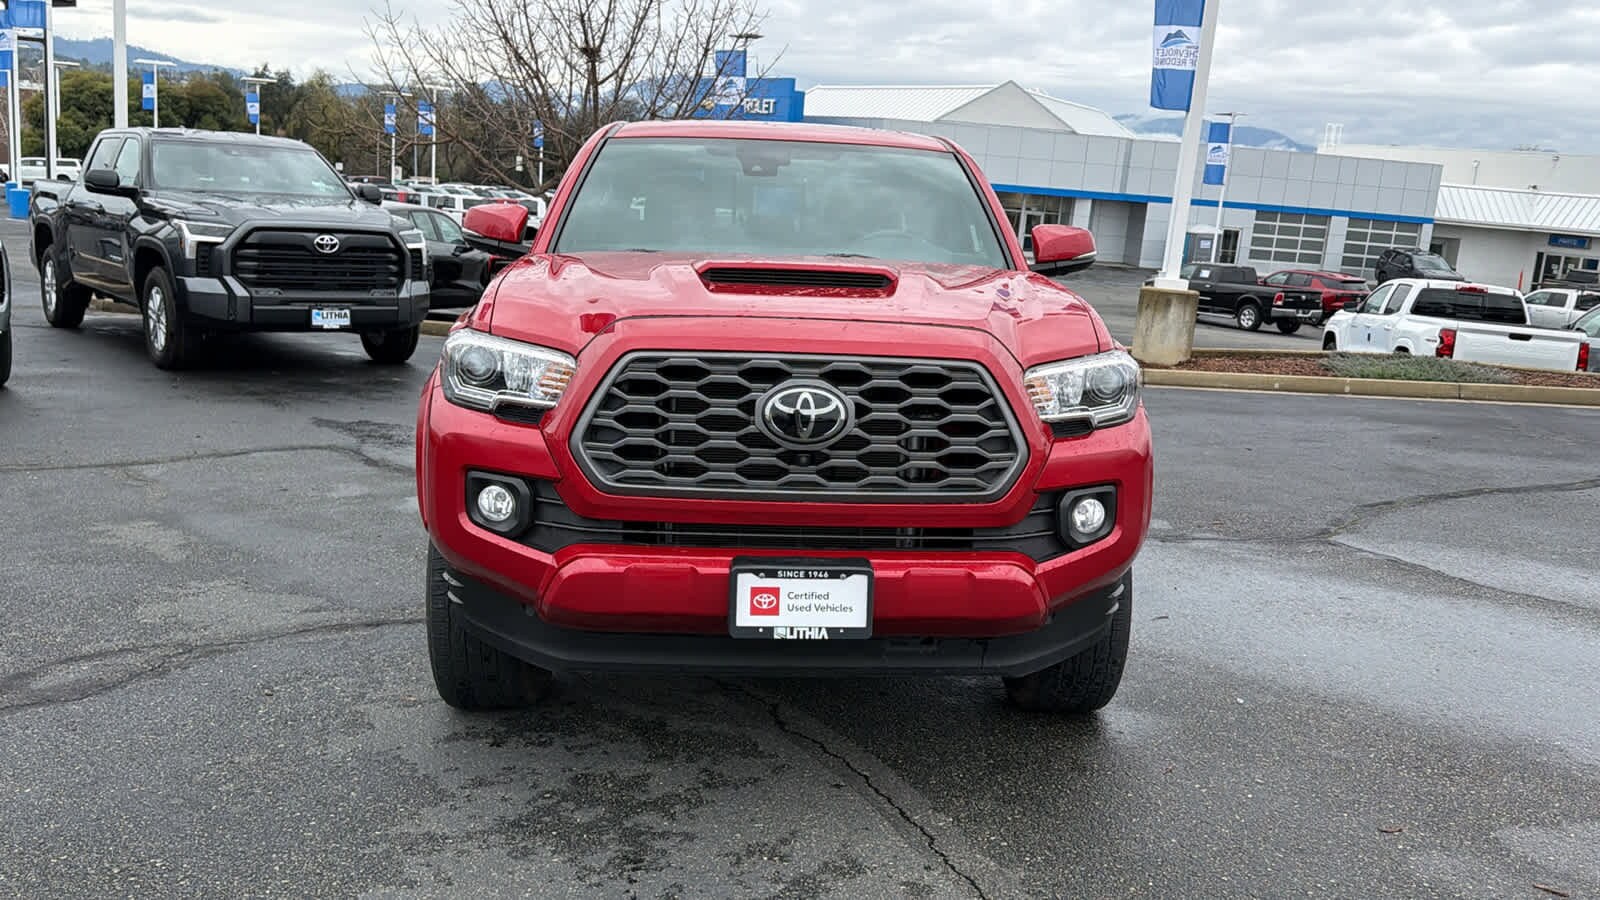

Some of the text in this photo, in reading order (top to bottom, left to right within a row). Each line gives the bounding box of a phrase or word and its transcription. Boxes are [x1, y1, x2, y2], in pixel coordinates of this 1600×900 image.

[322, 312, 349, 320] LITHIA
[787, 591, 829, 600] Certified
[787, 604, 853, 613] Used Vehicles
[786, 627, 828, 639] LITHIA
